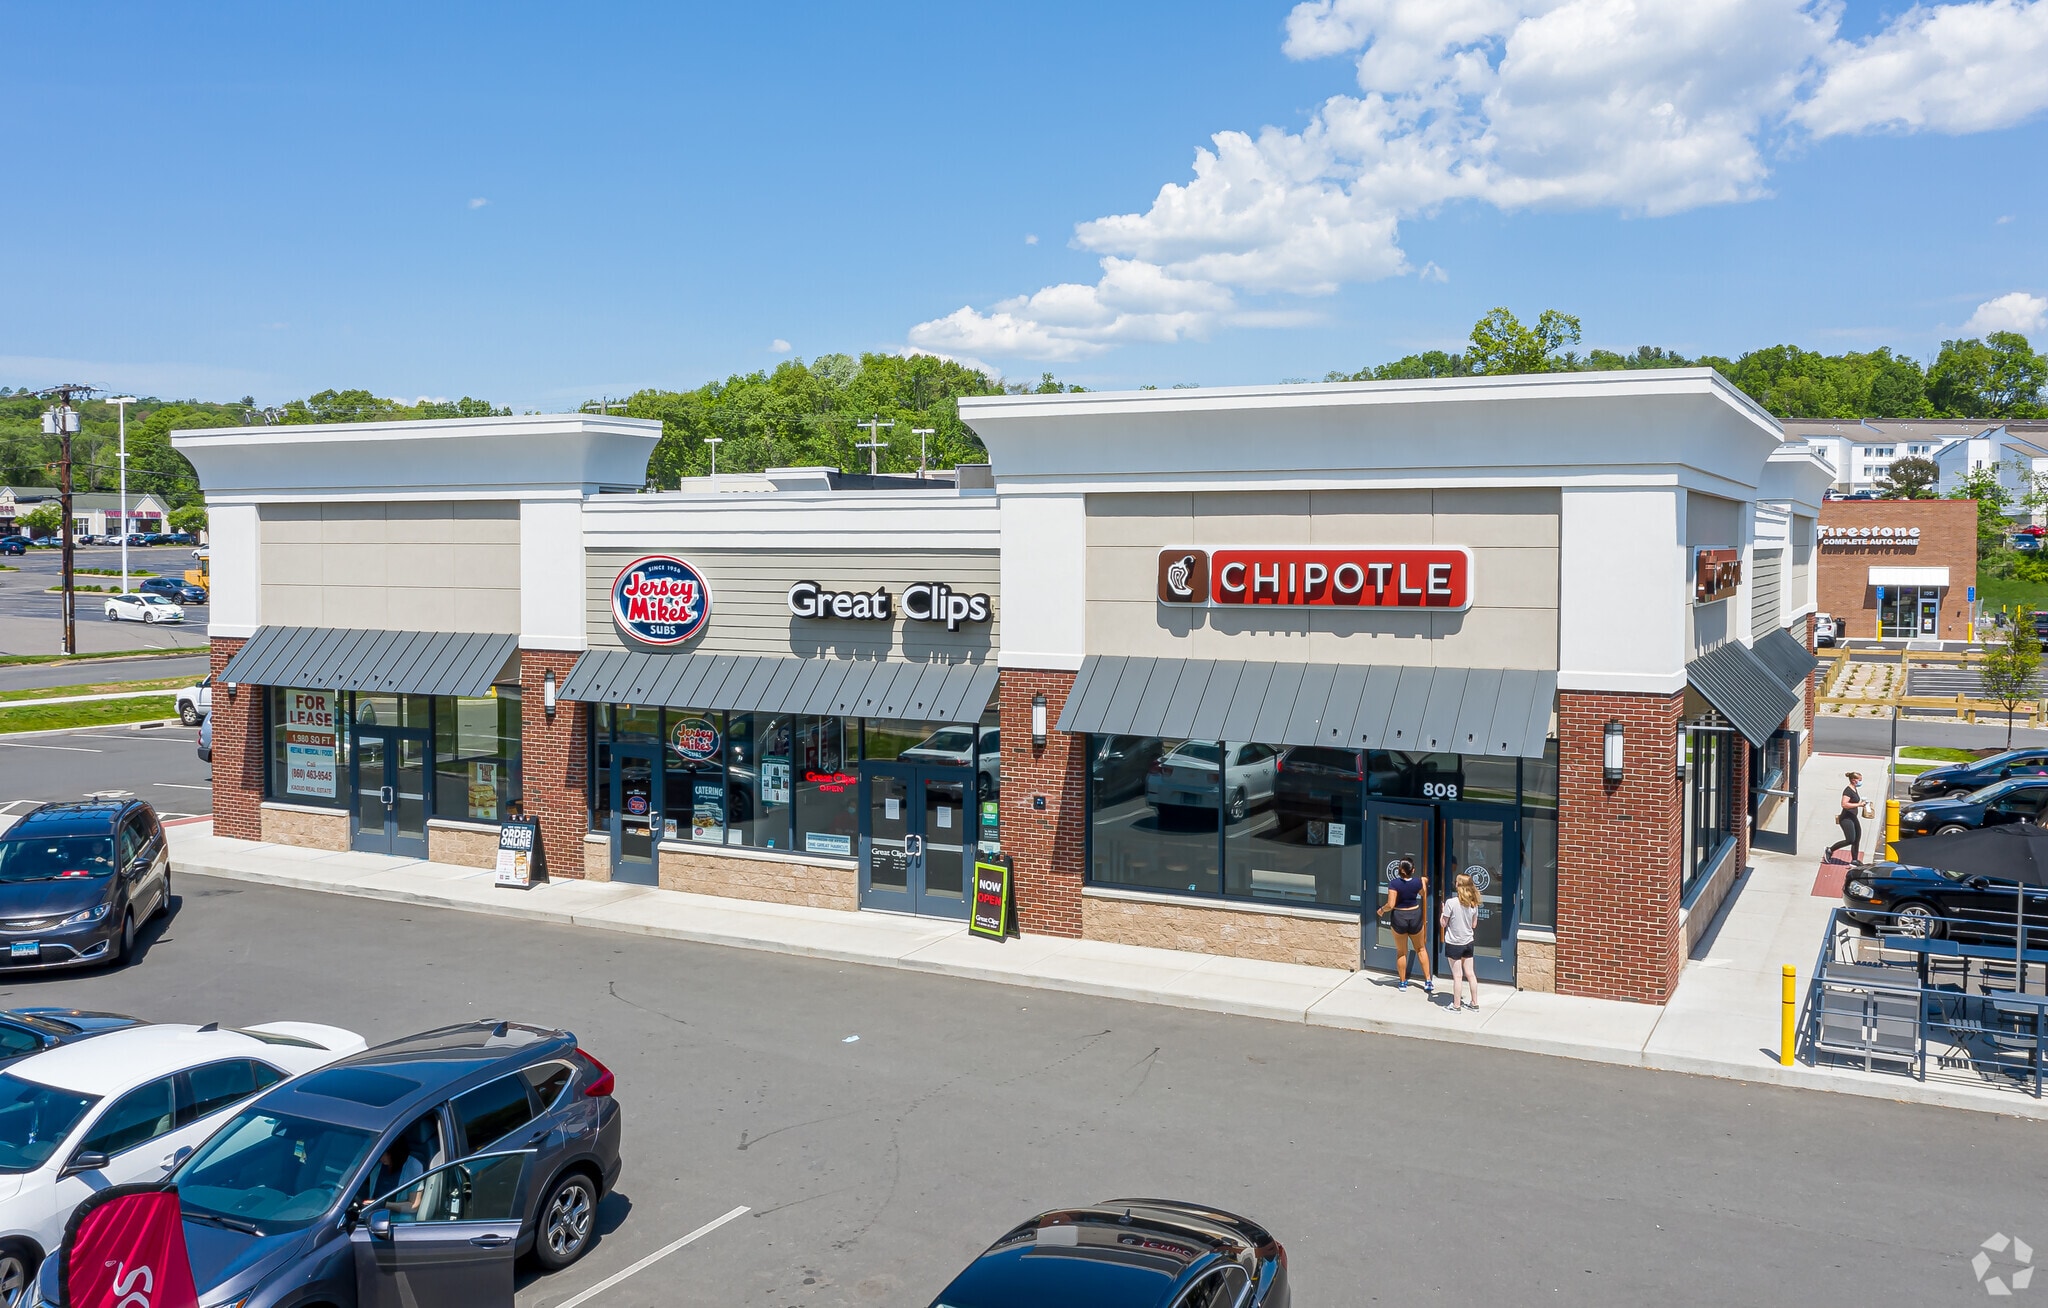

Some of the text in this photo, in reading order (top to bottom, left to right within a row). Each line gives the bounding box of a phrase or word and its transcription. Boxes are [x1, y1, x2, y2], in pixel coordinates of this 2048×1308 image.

[1816, 525, 1921, 540] Firestone
[1895, 538, 1920, 546] CARE
[648, 564, 681, 574] SINCE 1956
[1220, 562, 1452, 594] CHIPOTLE
[624, 572, 696, 604] Jersey
[628, 597, 692, 622] Mike's
[787, 581, 989, 631] Great Clips
[650, 625, 676, 635] SUBS
[296, 695, 325, 711] FOR
[290, 711, 333, 727] LEASE
[677, 723, 714, 742] Jersey
[292, 734, 331, 745] 1,980 SQ FT
[678, 737, 713, 752] Mike's
[322, 749, 334, 757] FOOD
[805, 771, 858, 786] Great Clips
[695, 785, 723, 797] CATERING
[819, 784, 845, 793] OPEN
[1423, 782, 1458, 798] 808
[501, 828, 533, 840] ORDER
[501, 837, 532, 848] ONLINE
[871, 847, 907, 858] Great Clips
[979, 879, 1001, 892] NOW
[977, 892, 1002, 906] OPEN
[976, 914, 988, 922] Great
